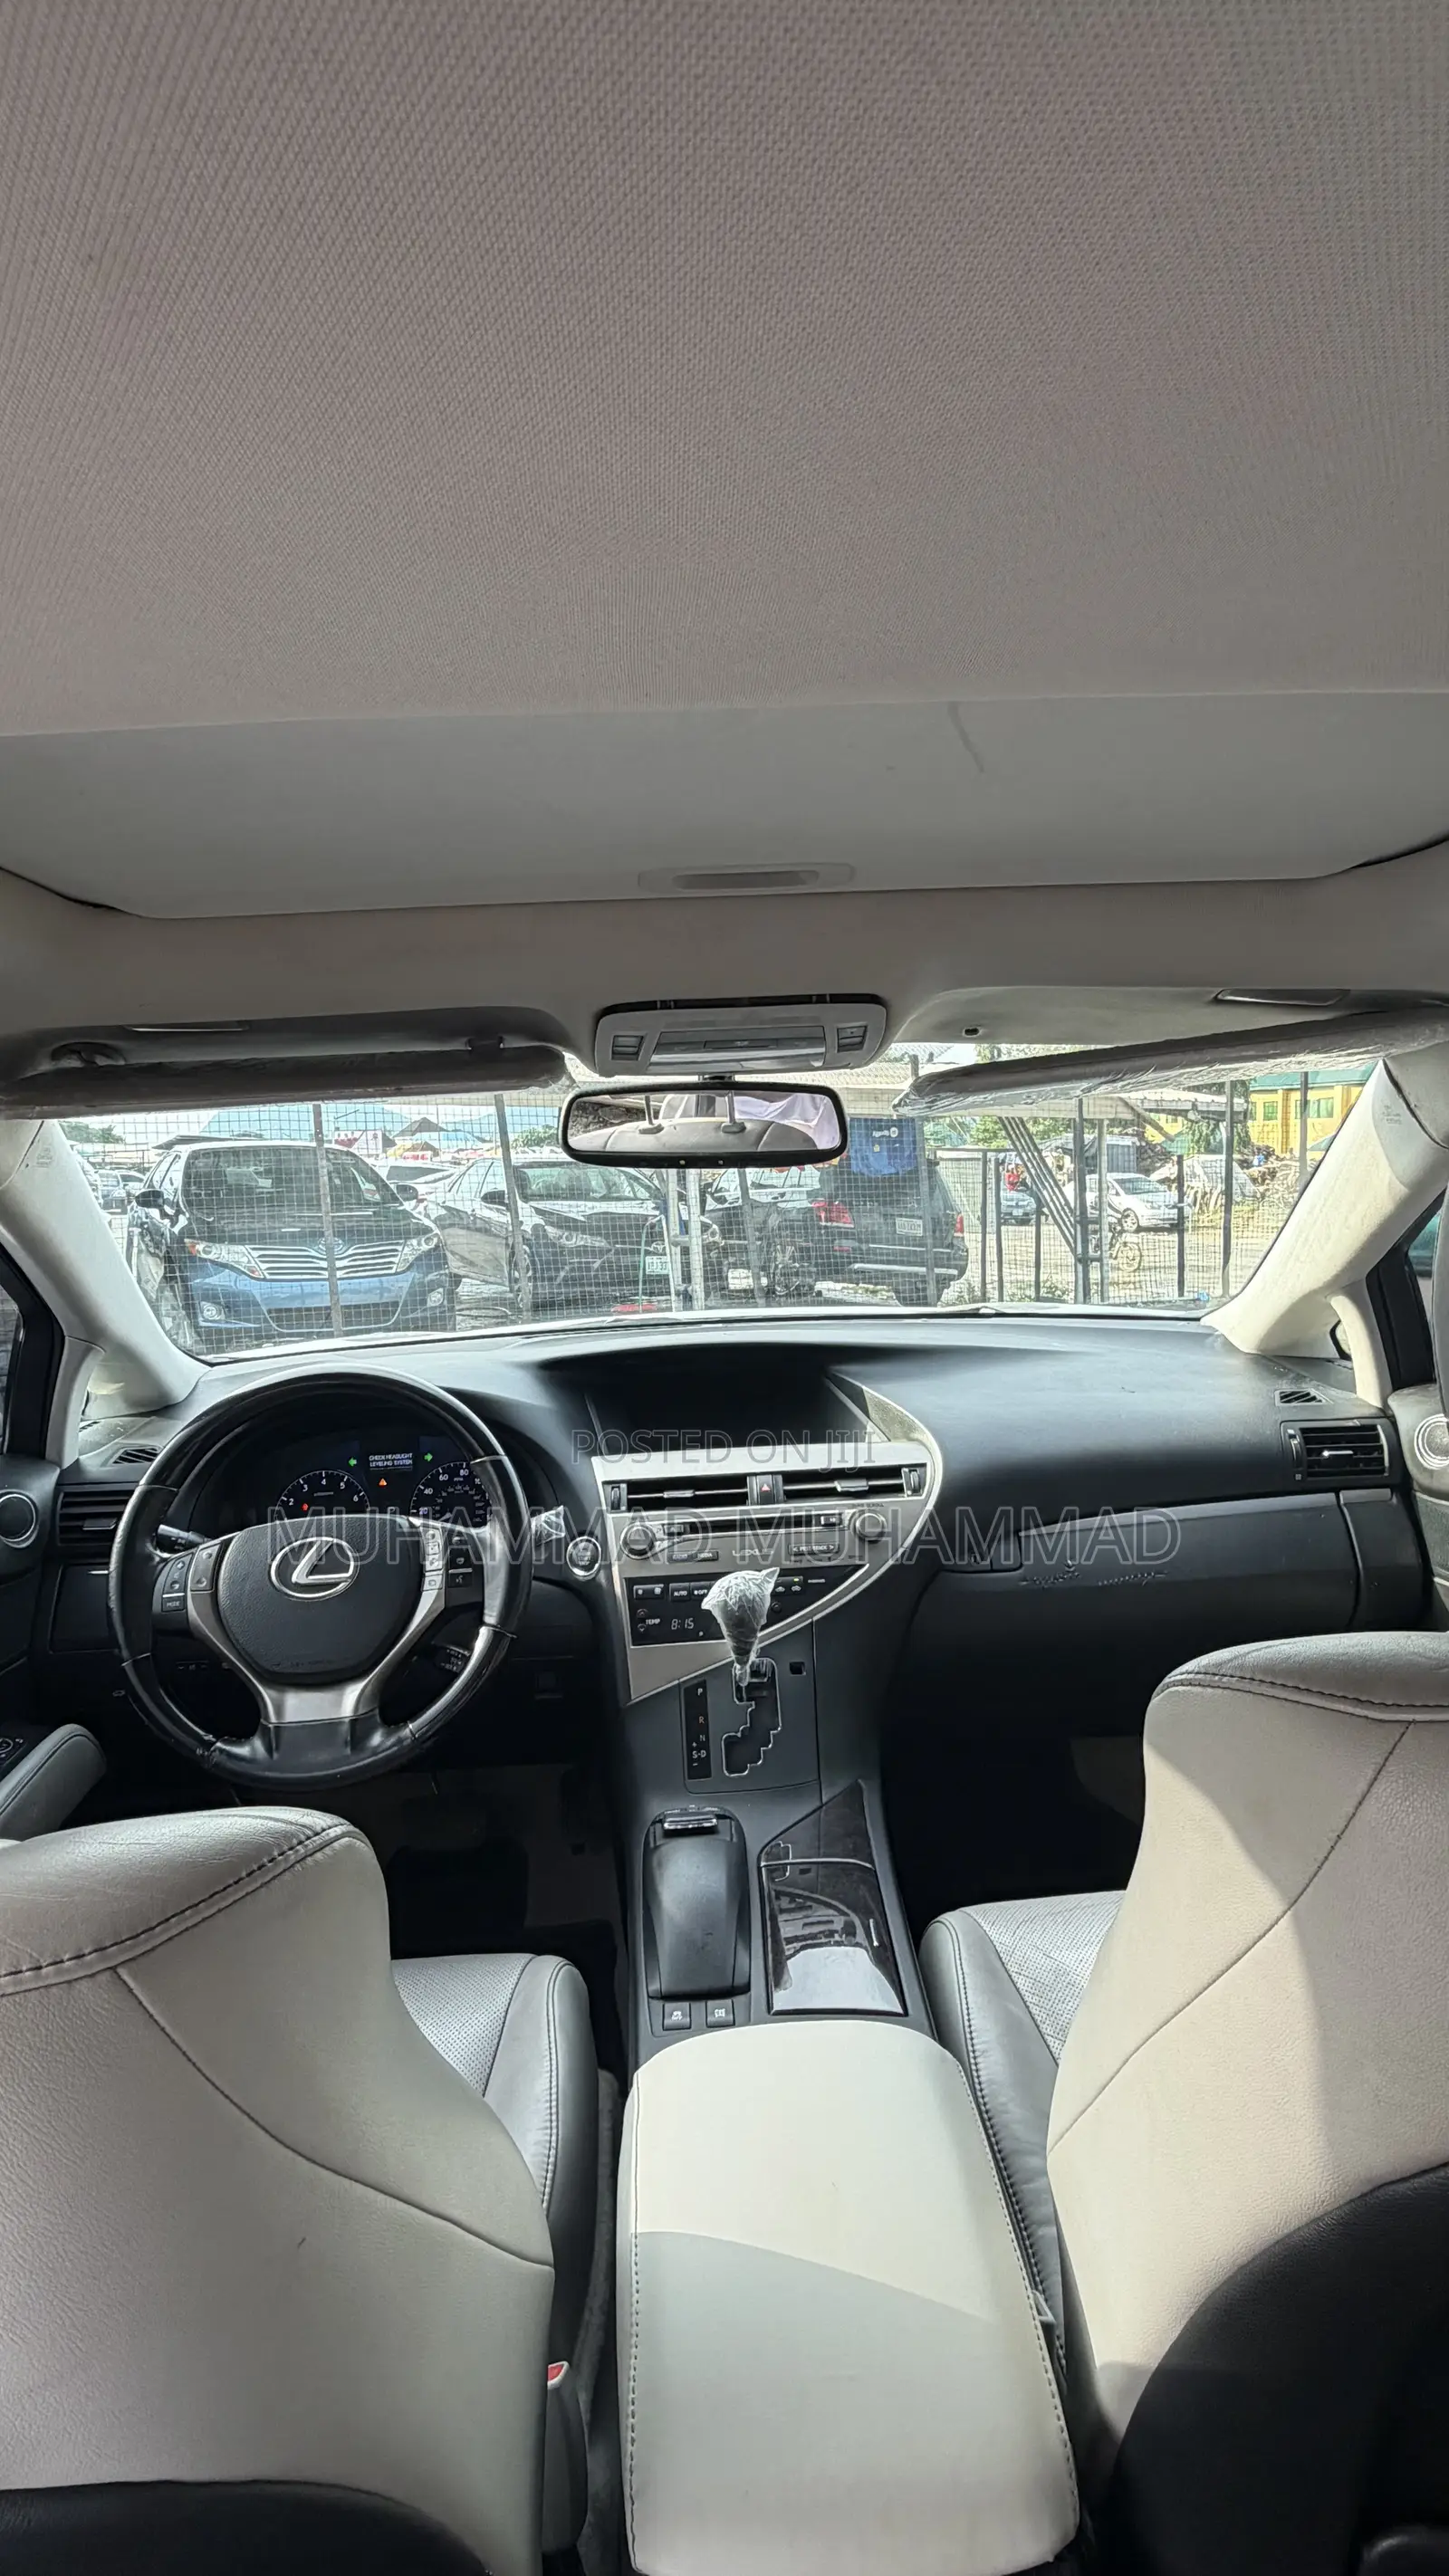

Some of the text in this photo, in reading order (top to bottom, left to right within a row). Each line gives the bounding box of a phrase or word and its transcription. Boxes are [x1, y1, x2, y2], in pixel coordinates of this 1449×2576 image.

[438, 1473, 449, 1481] 60
[302, 1484, 308, 1492] 3
[340, 1481, 345, 1489] 5
[288, 1498, 294, 1506] 2
[671, 1617, 695, 1630] 8:15
[697, 1688, 703, 1696] P
[698, 1716, 705, 1724] R
